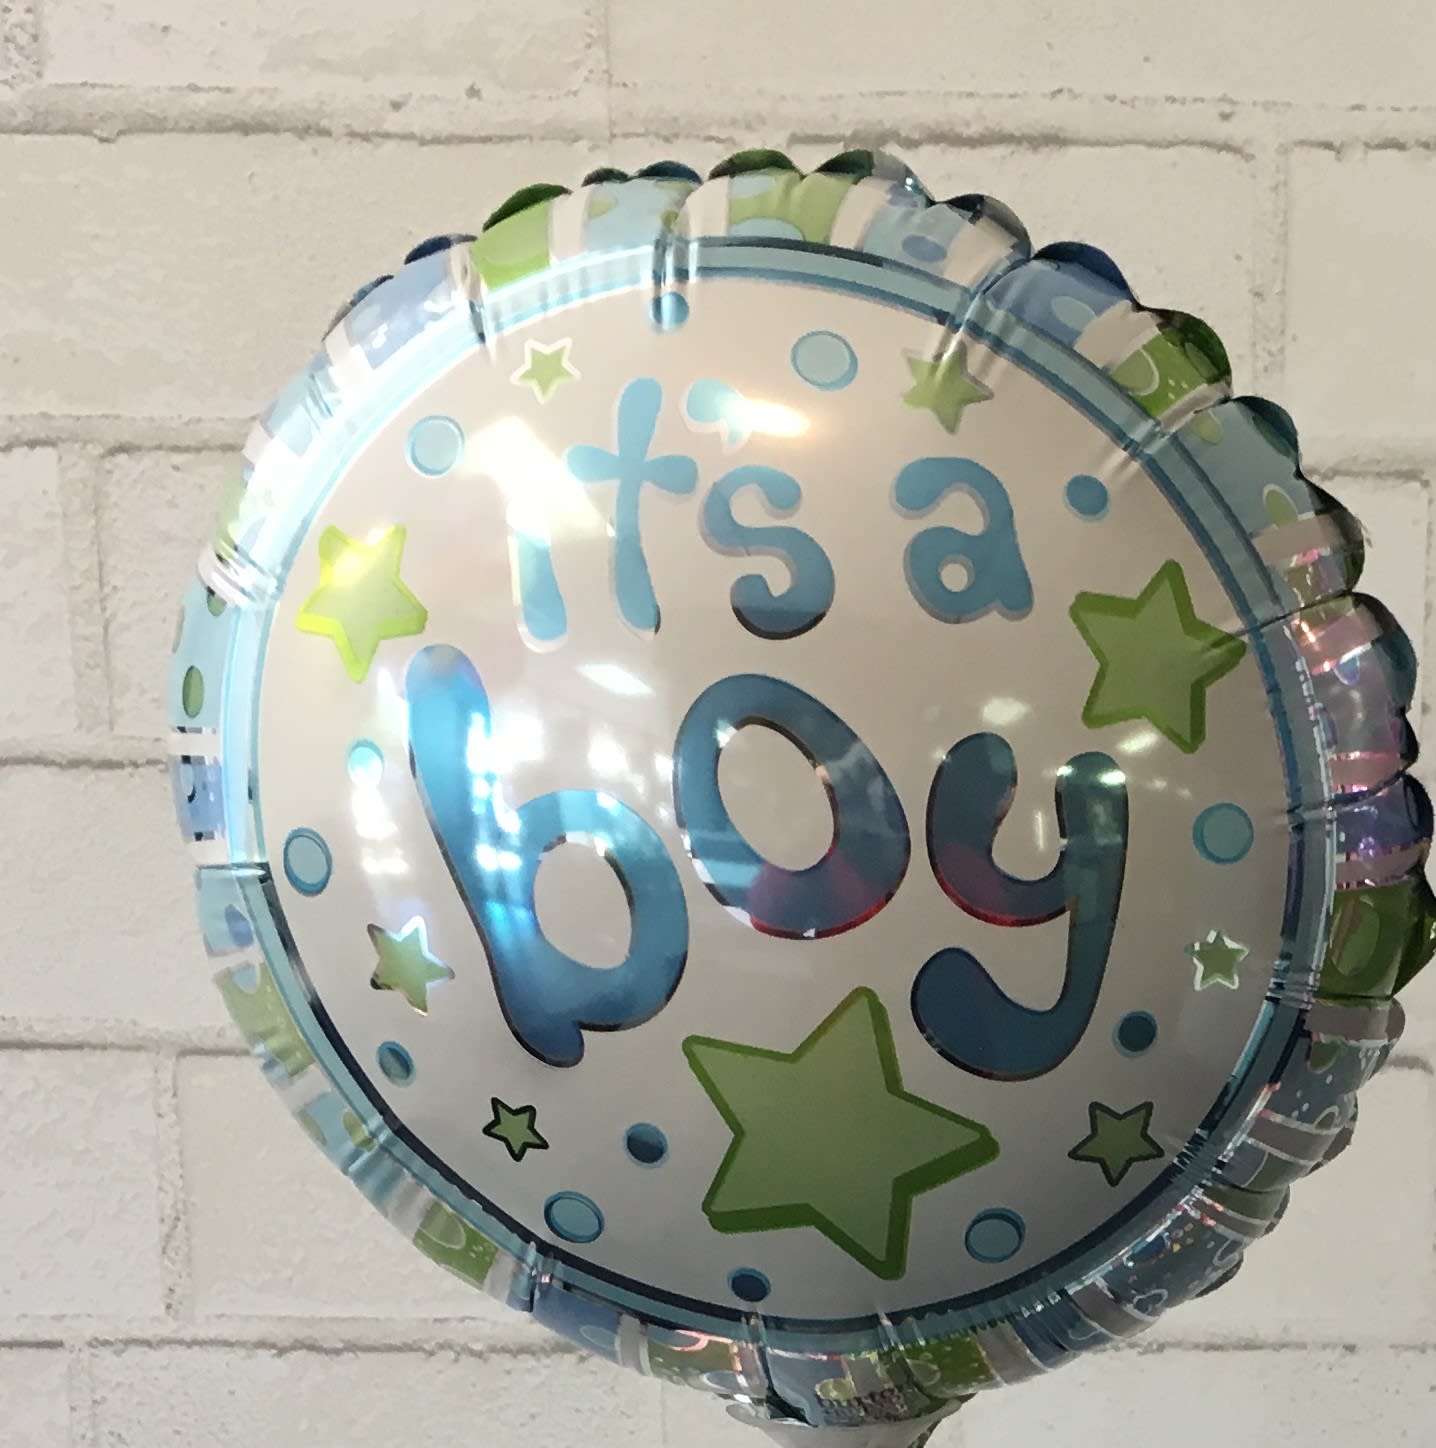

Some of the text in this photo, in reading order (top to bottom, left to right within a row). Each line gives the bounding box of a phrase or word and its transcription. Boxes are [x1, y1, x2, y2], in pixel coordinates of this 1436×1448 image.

[500, 377, 1034, 652] it's a
[404, 643, 1129, 1082] boy
